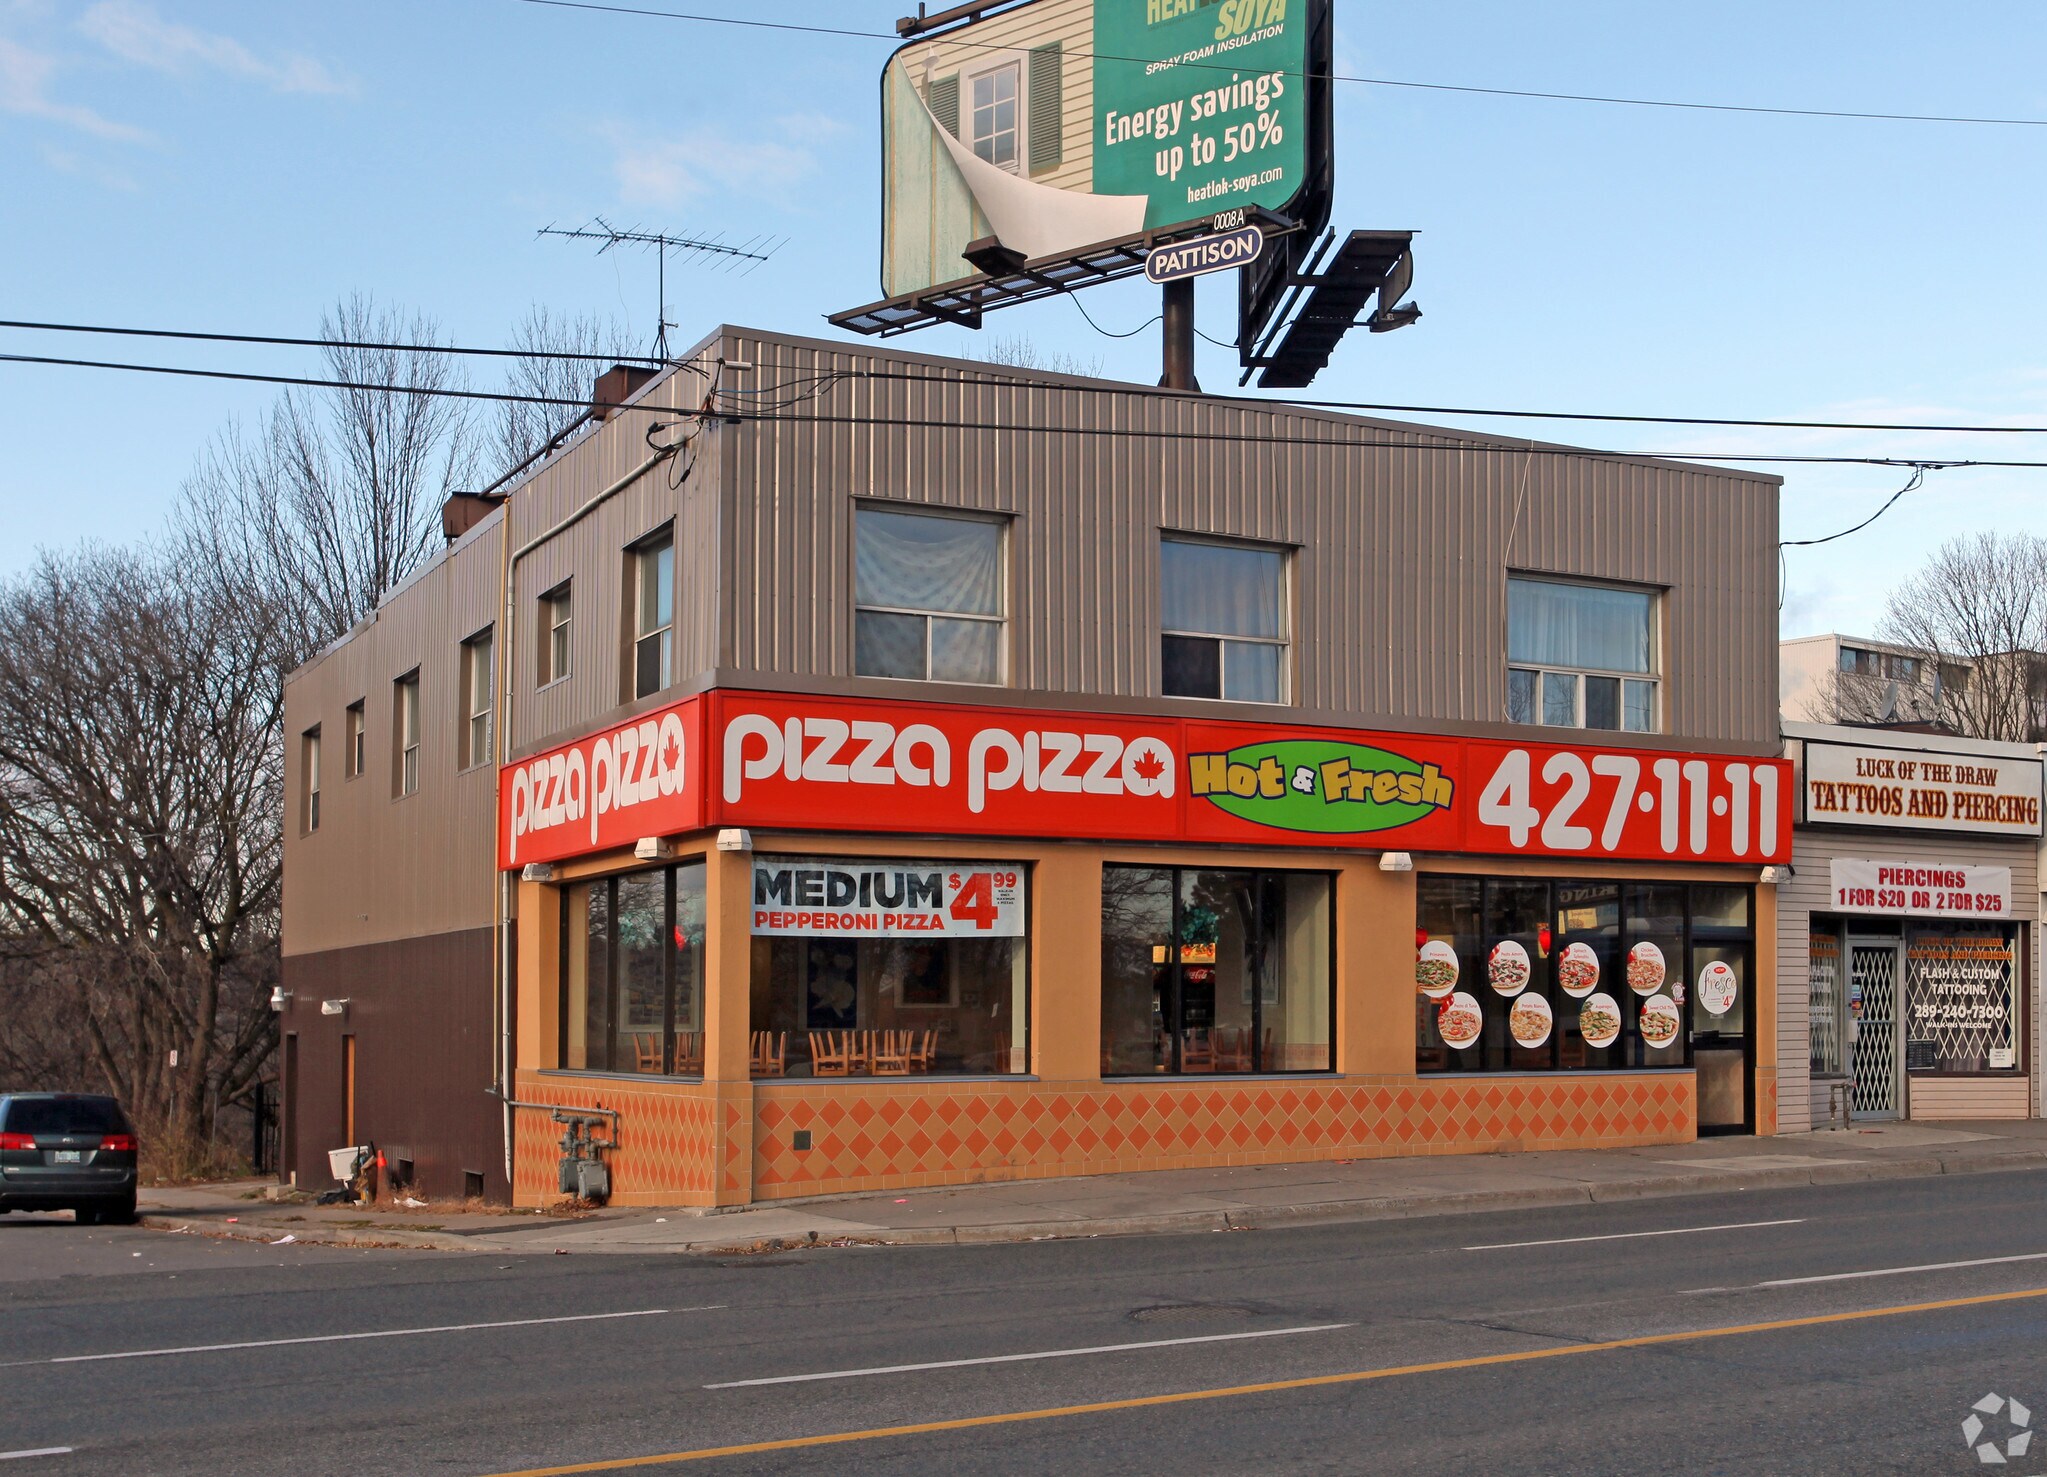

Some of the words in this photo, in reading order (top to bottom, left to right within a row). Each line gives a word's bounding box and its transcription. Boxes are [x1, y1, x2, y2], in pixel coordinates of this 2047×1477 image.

[1214, 0, 1286, 40] SOYA
[1145, 56, 1181, 75] SPRAY
[1182, 45, 1214, 64] FOAM
[1216, 23, 1284, 53] INSULATION
[1106, 100, 1184, 146] Energy
[1190, 71, 1284, 122] savings
[1155, 146, 1184, 182] up
[1191, 133, 1216, 167] to
[1223, 109, 1283, 162] 50%
[1187, 167, 1283, 203] heatlok-soya.com
[1155, 234, 1253, 275] PATTISON
[1188, 753, 1286, 799] Hot
[1291, 766, 1316, 795] &
[1319, 757, 1455, 811] Fresh
[1856, 757, 1895, 779] LUCK
[1898, 761, 1916, 780] OF
[1921, 762, 1952, 783] THE
[1955, 765, 1998, 787] DRAW
[1810, 780, 1903, 817] TATTOOS
[1906, 788, 1948, 819] AND
[1952, 791, 2039, 826] PIERCING
[754, 868, 943, 909] MEDIUM
[1878, 867, 1966, 888] PIERCINGS
[1838, 887, 1846, 905] 1
[1849, 888, 1875, 906] FOR
[1878, 889, 1906, 908] $20
[1911, 891, 1931, 908] OR
[1936, 892, 1945, 909] 2
[1948, 892, 1973, 910] FOR
[1975, 893, 2002, 912] $25
[754, 912, 878, 930] PEPPERONI
[883, 913, 945, 930] PIZZA
[1920, 968, 1950, 979] FLASH
[1952, 968, 1959, 979] &
[1961, 968, 2000, 980] CUSTOM
[1932, 984, 1987, 995] TATTOOING
